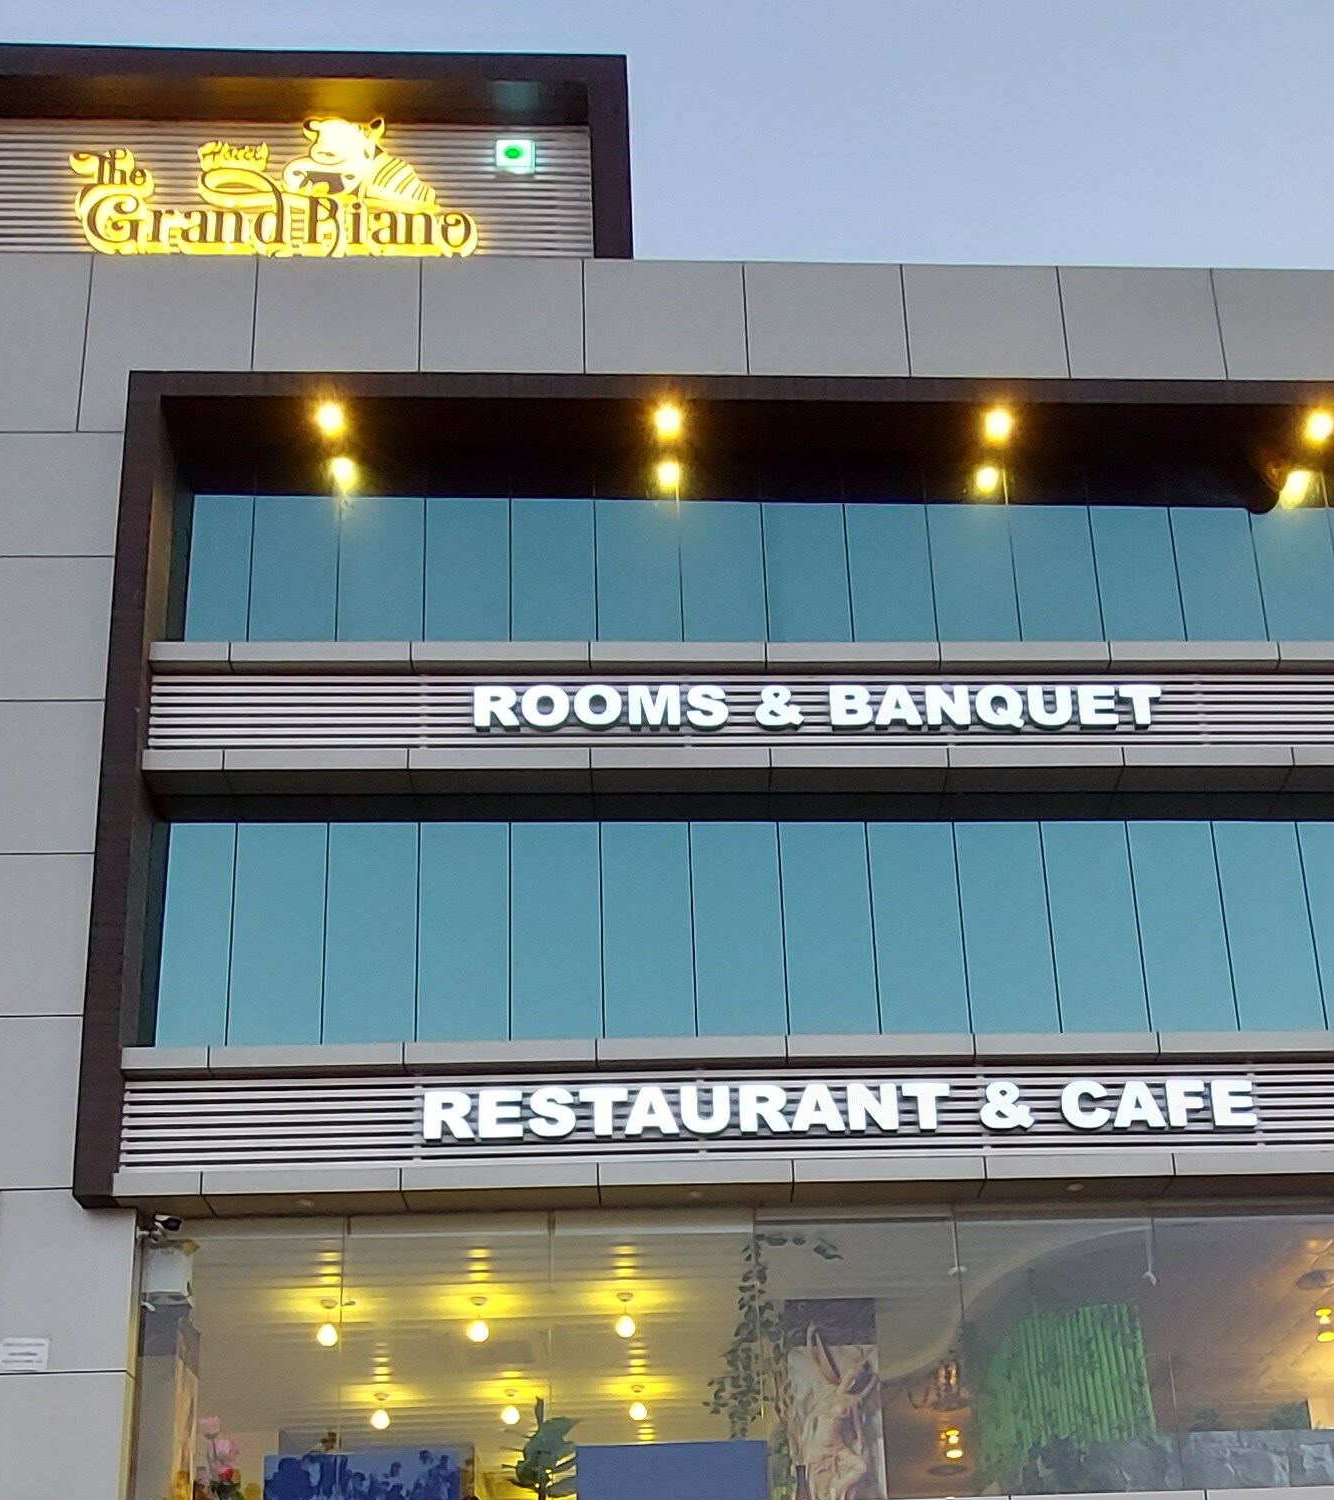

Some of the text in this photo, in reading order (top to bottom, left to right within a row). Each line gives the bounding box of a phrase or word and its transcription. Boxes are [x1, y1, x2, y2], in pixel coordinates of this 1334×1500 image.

[72, 148, 148, 187] The
[85, 168, 472, 254] Grand Piano
[473, 683, 1162, 733] ROOMS & BANQUET
[423, 1078, 1259, 1141] RESTAURANT & CAFE
